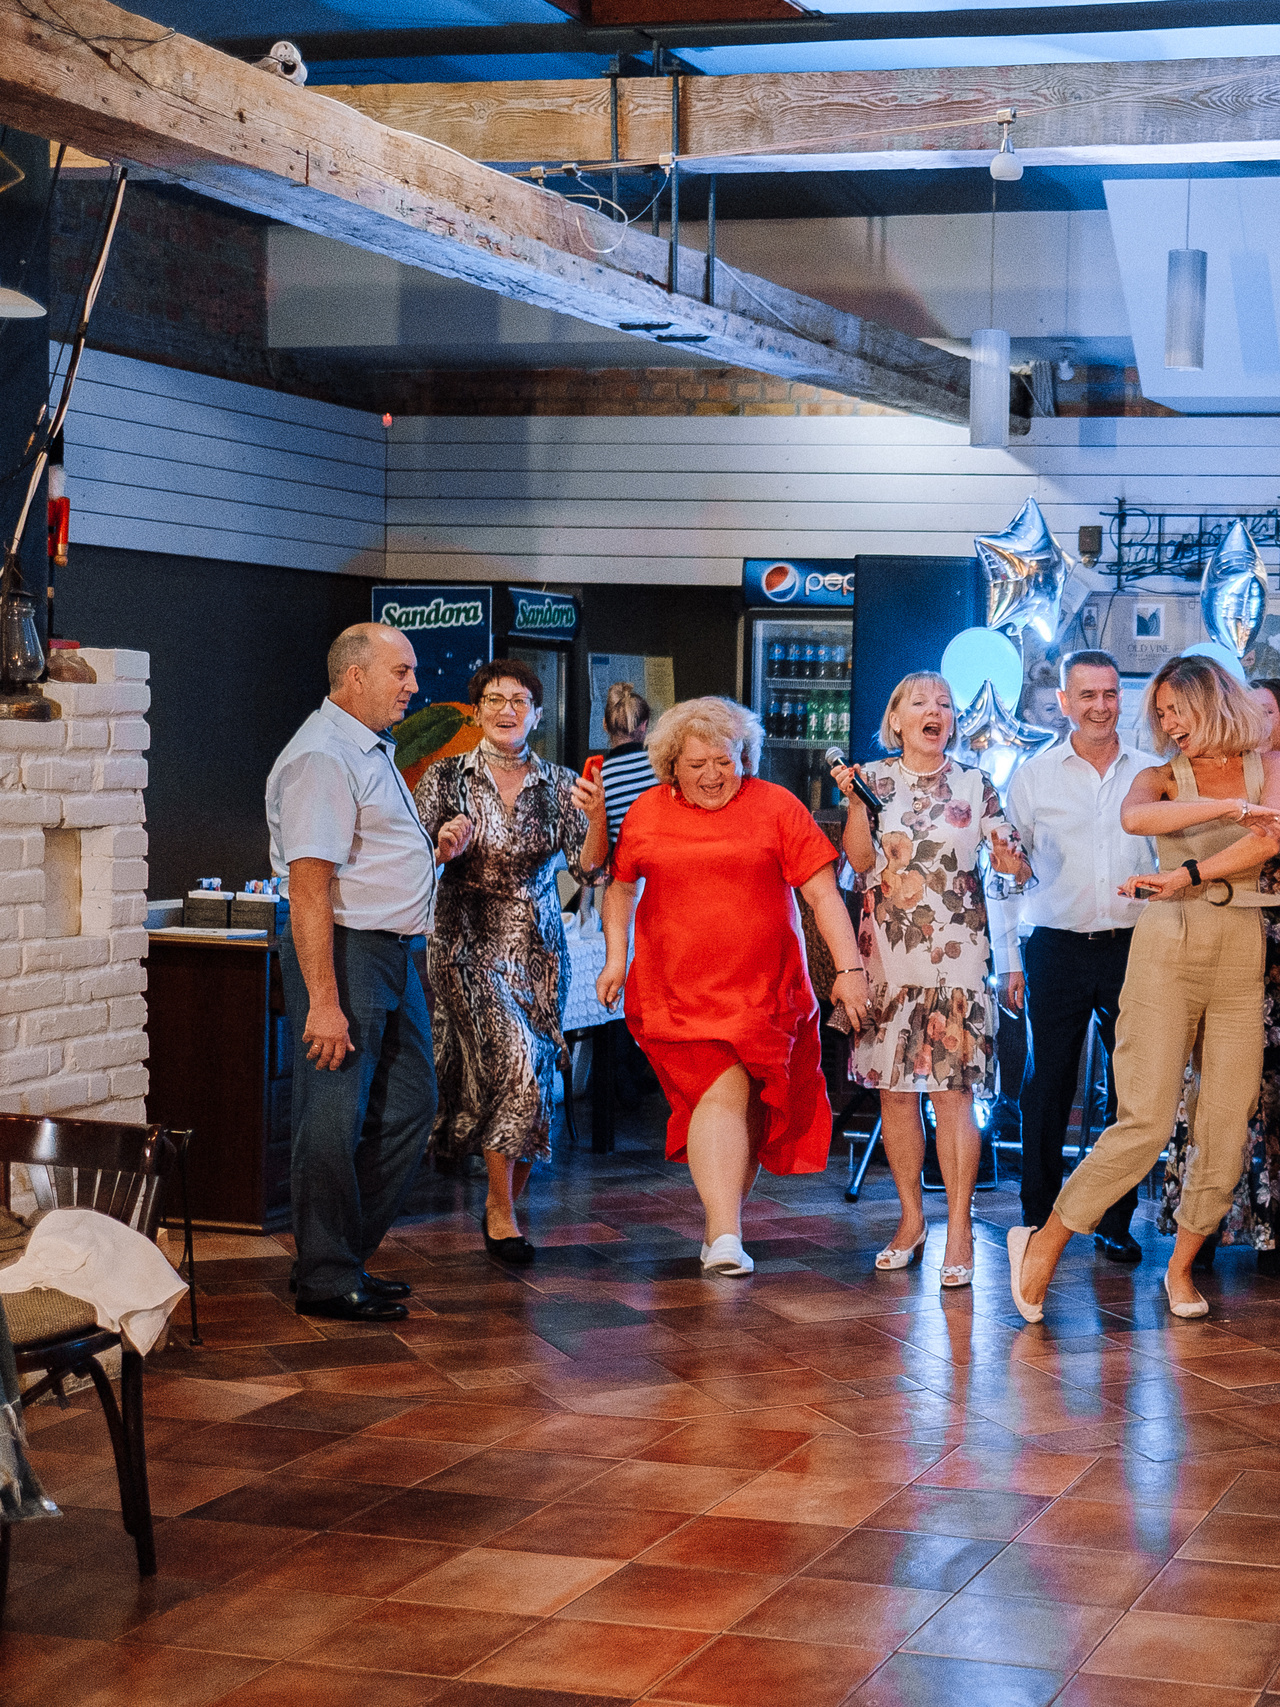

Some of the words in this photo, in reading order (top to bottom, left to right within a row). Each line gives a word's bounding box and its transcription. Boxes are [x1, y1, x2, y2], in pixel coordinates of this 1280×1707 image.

[805, 572, 855, 596] pep
[381, 598, 483, 631] Sandora
[515, 598, 576, 629] Sandora
